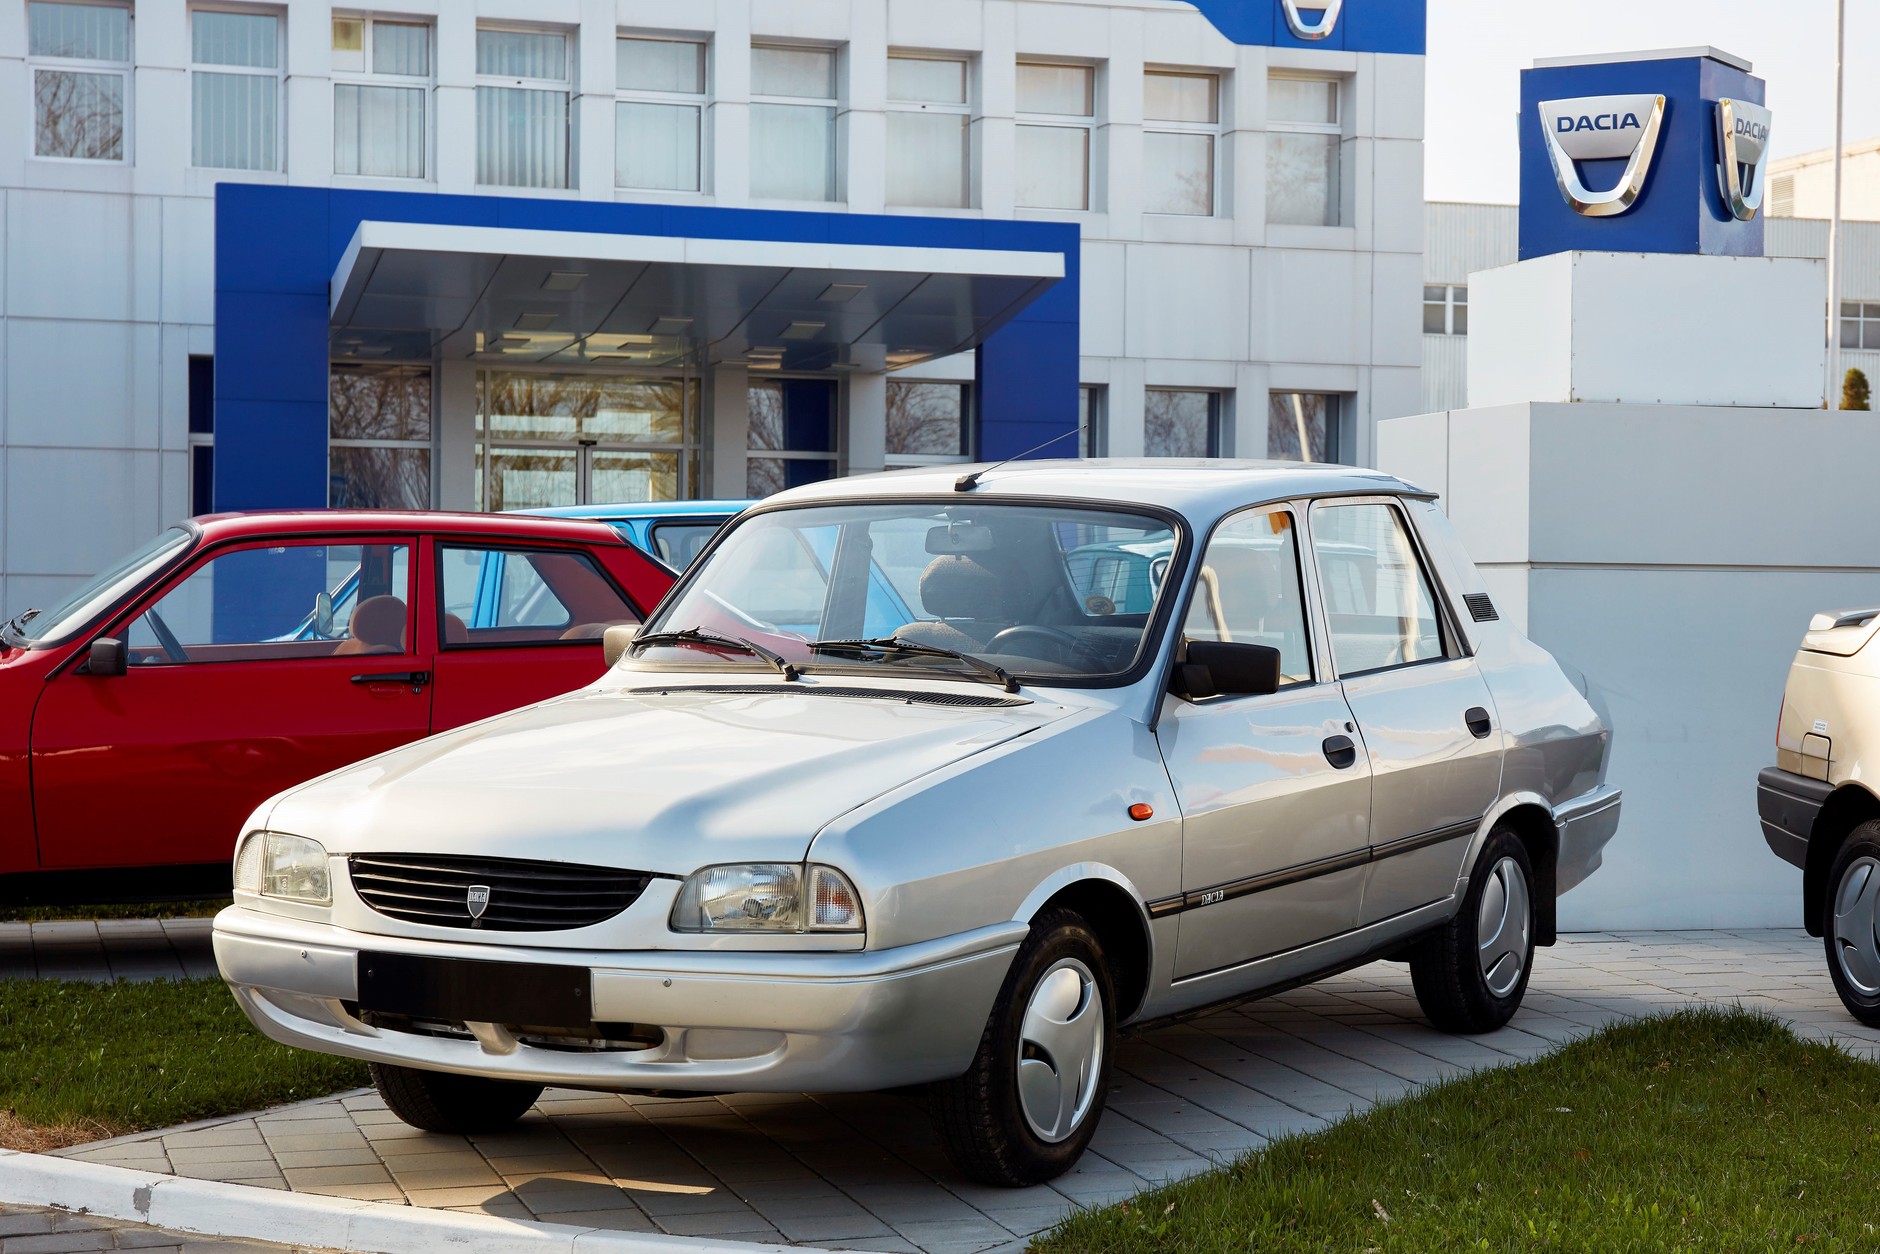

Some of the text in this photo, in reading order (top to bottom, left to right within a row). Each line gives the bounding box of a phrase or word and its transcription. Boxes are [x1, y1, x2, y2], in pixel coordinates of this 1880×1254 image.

[1556, 112, 1641, 133] DACIA
[1735, 117, 1767, 142] DACIA
[1201, 889, 1224, 906] DACIA
